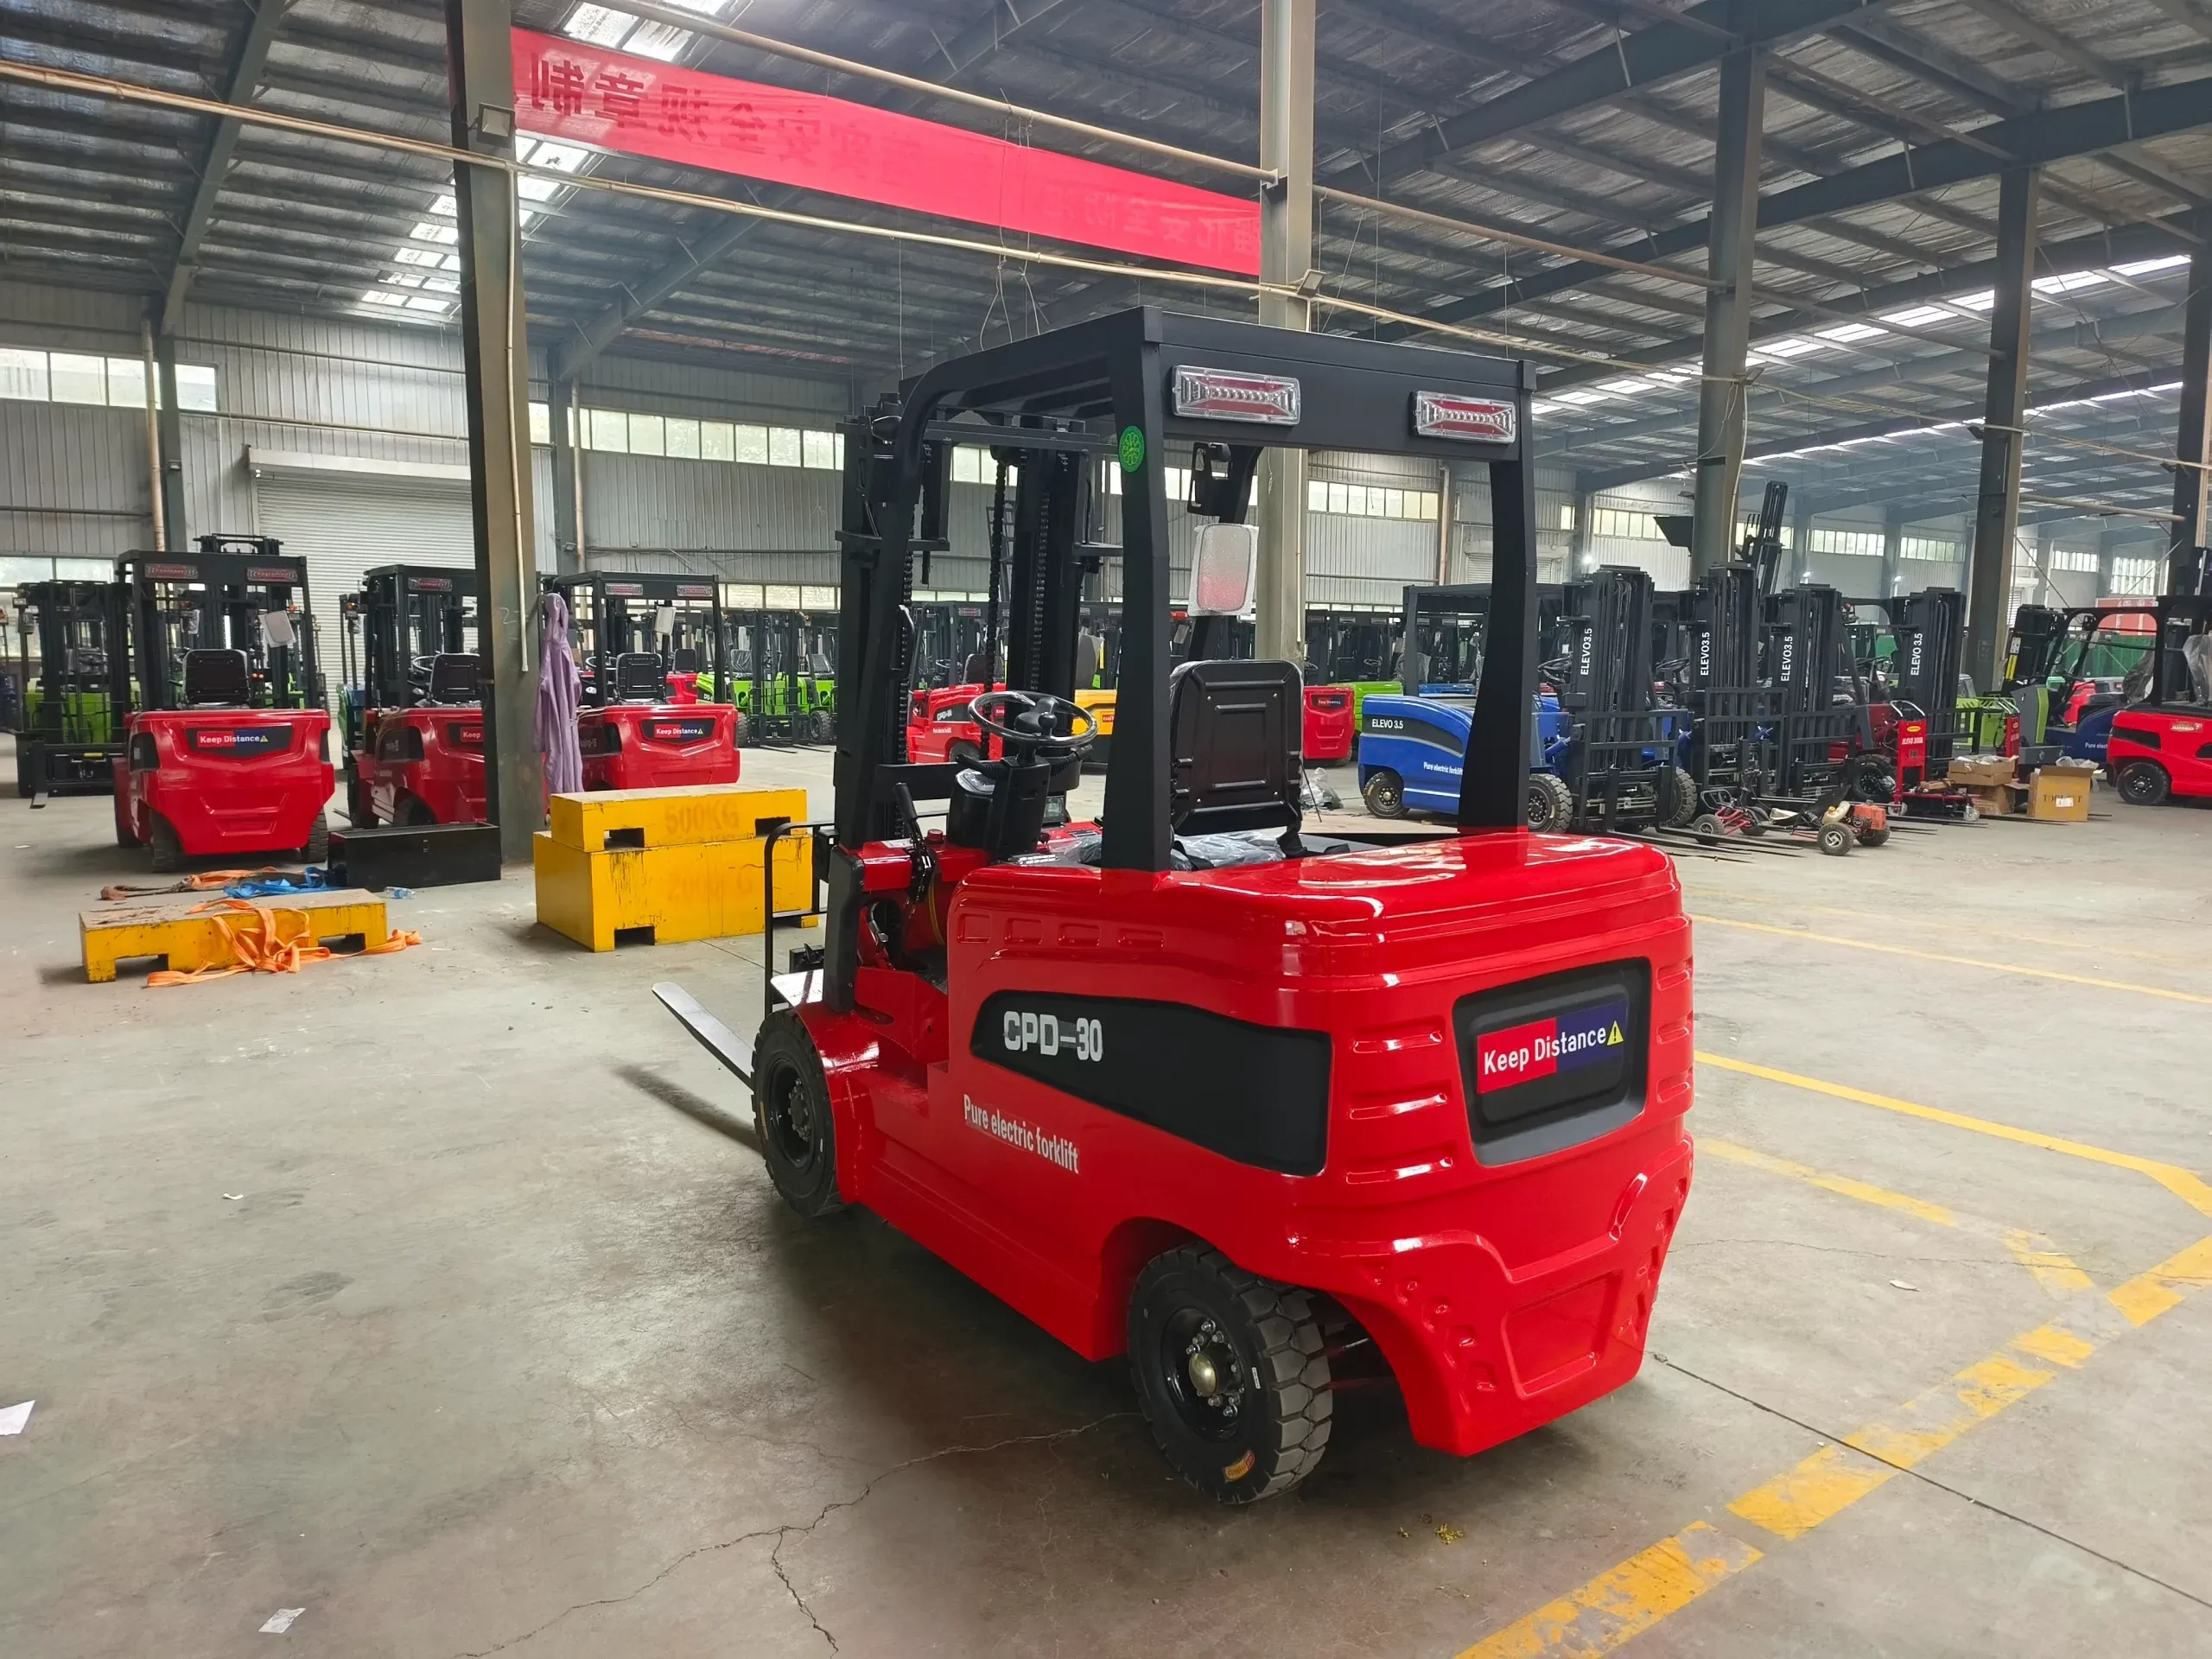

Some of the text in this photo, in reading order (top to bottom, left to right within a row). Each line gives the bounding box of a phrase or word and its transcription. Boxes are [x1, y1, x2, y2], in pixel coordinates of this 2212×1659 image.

[200, 734, 259, 744] Keep Distance
[656, 728, 671, 736] Keep
[1372, 718, 1403, 729] ELEVO 3.5
[664, 798, 741, 836] 500KG
[1003, 1010, 1103, 1063] CPD-30
[1484, 1027, 1606, 1076] Keep Distance
[963, 1094, 1079, 1174] Pure electric forklift
